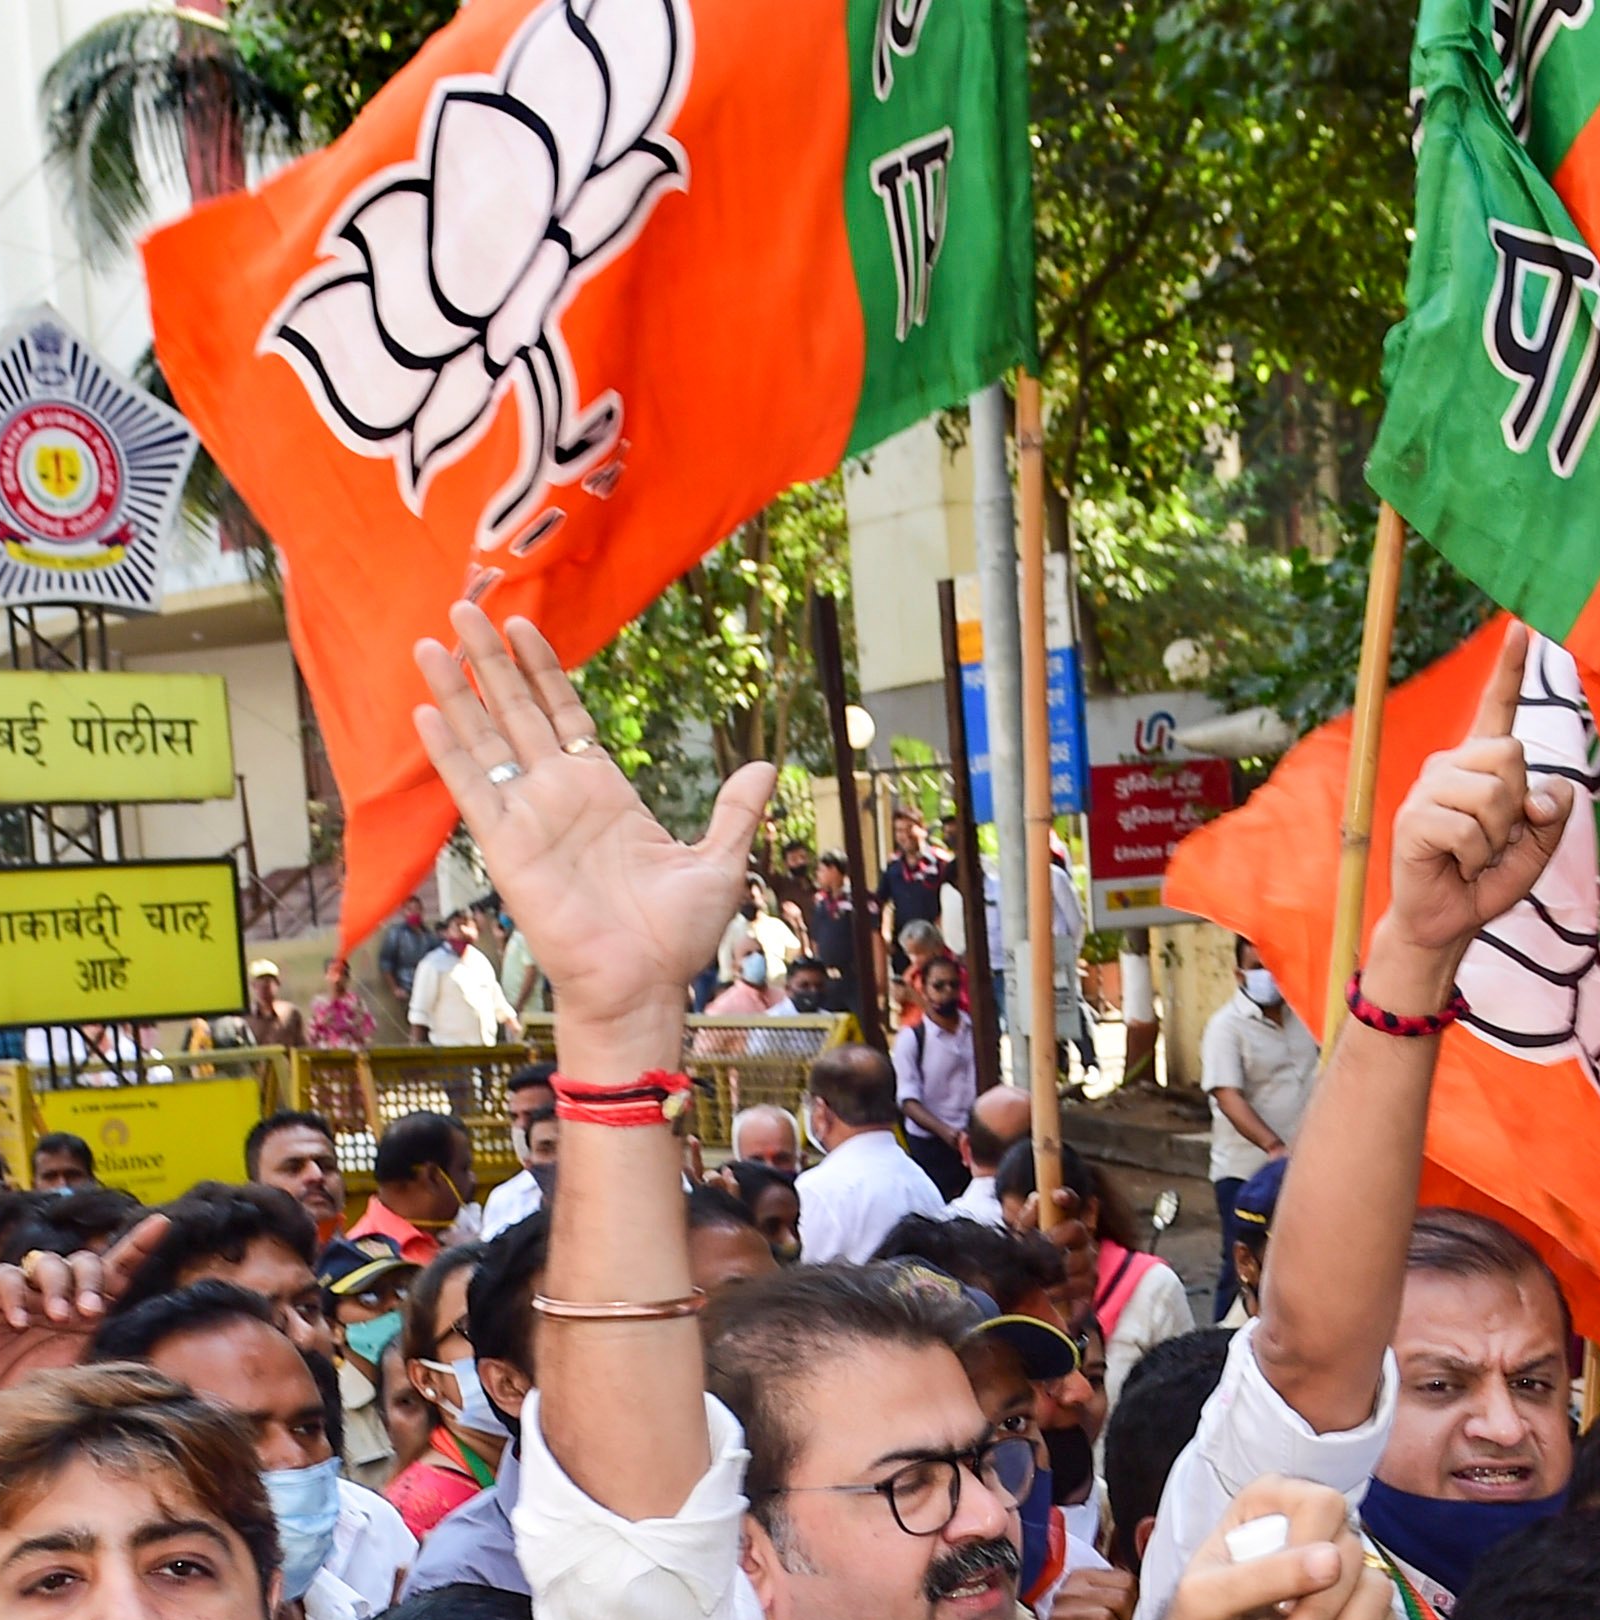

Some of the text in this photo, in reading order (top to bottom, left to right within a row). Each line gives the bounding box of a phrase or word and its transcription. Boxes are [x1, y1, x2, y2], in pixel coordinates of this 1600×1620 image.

[68, 701, 199, 757] पोलीस
[1113, 844, 1164, 863] Union
[139, 899, 214, 942] चालू
[74, 947, 133, 993] आहे
[93, 1150, 166, 1173] eliance
